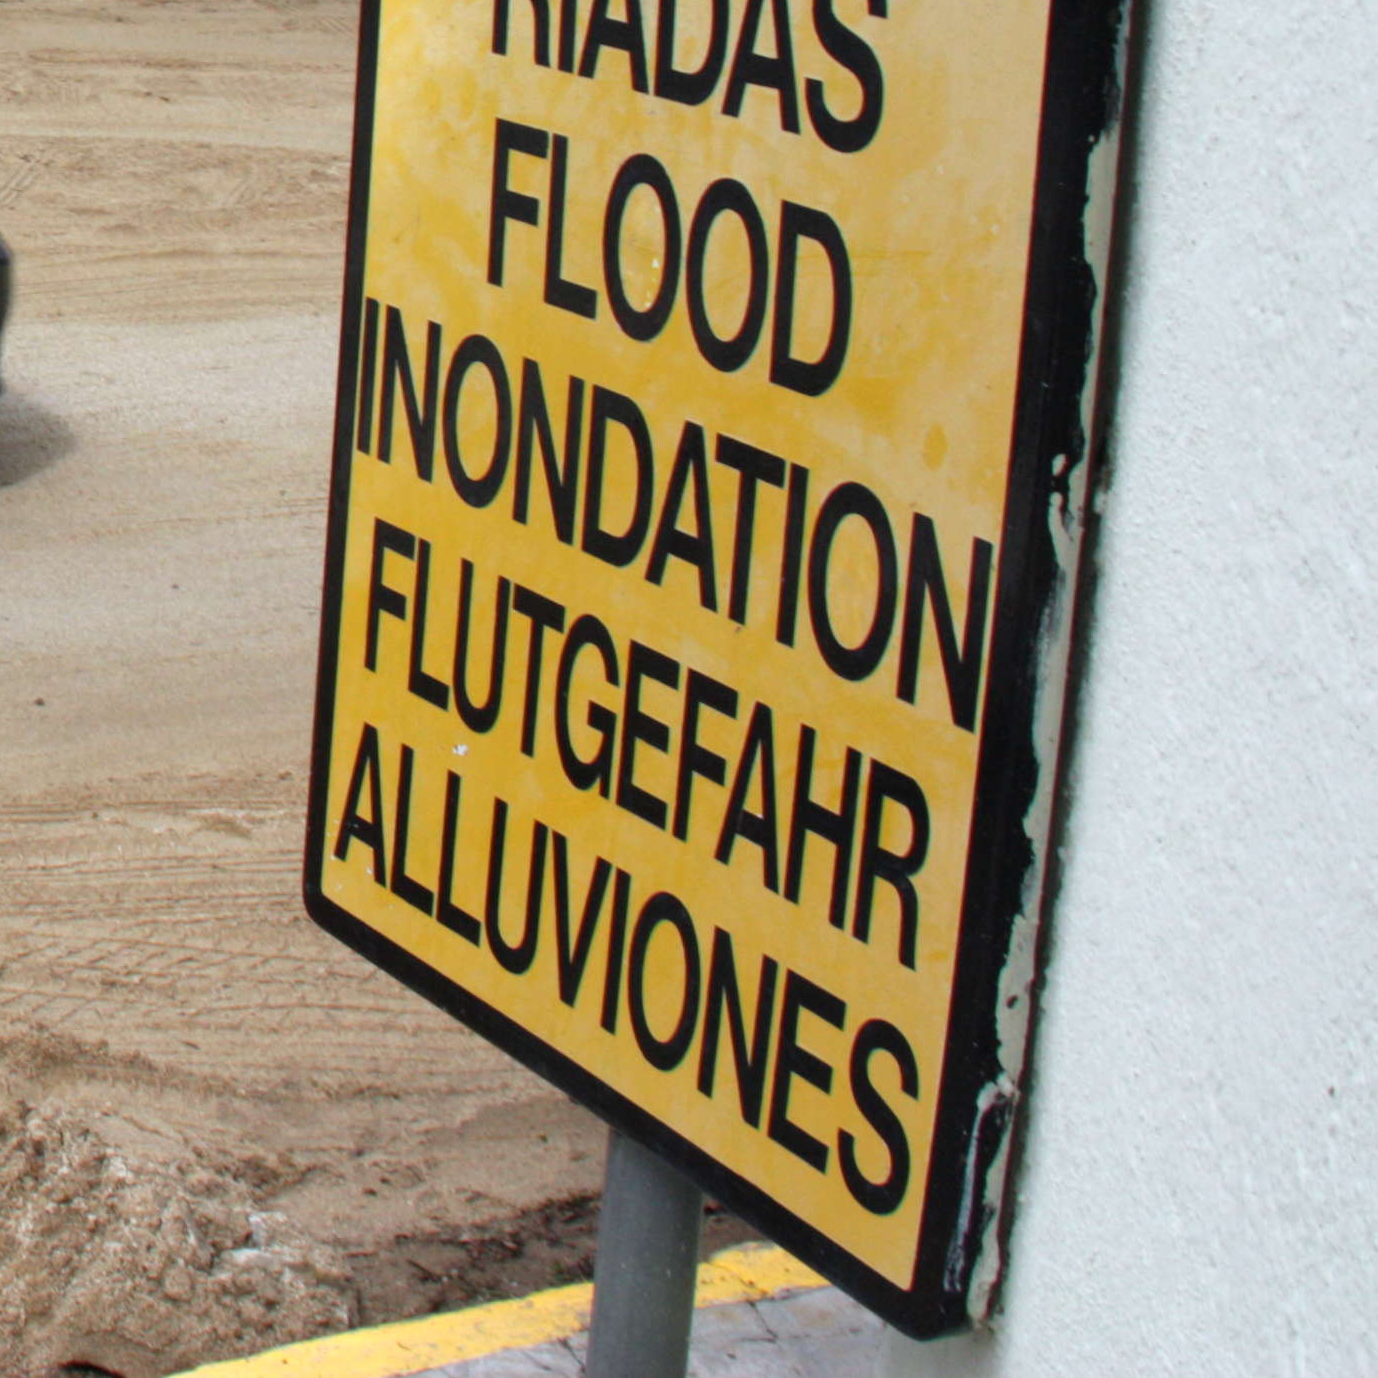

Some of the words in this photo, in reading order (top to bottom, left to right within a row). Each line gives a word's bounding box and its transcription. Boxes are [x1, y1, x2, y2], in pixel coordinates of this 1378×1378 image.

[486, 117, 853, 398] FLOOD
[356, 297, 994, 734] INONDATION
[363, 516, 933, 973] FLUTGEFAHR
[332, 724, 921, 1217] ALLUVIONES
